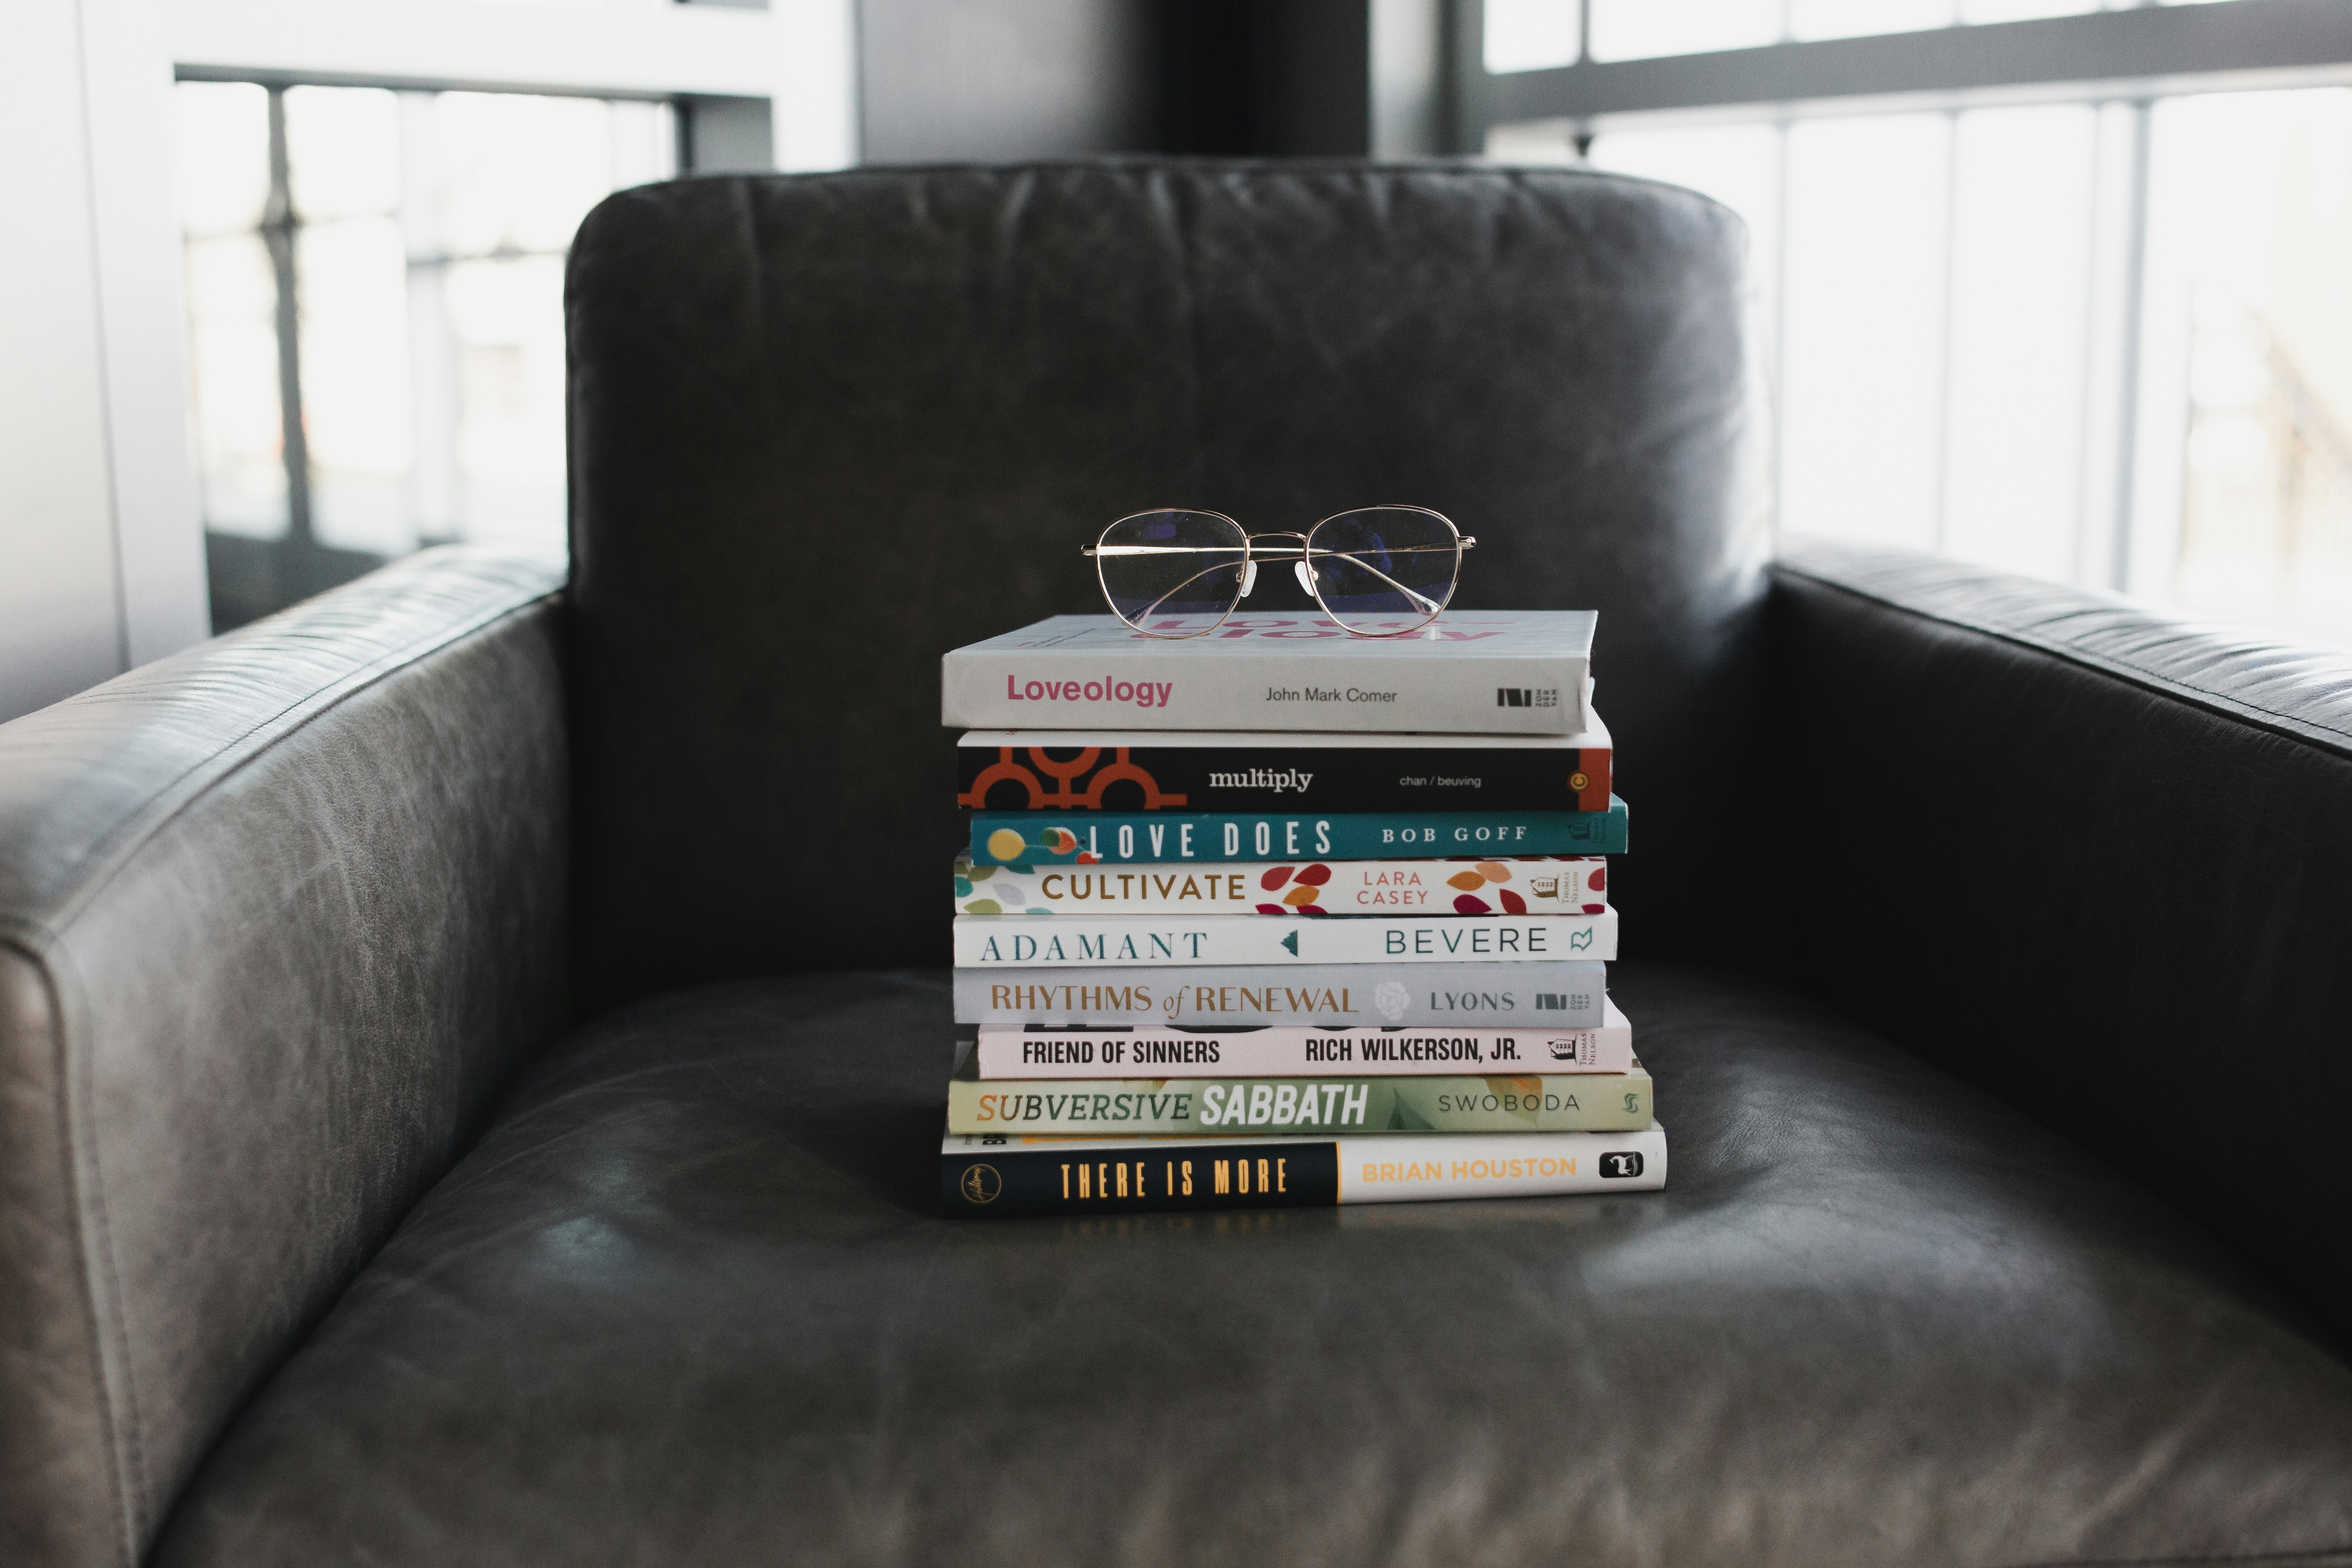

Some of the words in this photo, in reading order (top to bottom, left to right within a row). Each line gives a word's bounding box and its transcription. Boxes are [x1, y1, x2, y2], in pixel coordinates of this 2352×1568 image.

[1008, 675, 1173, 707] Loveology
[1266, 687, 1300, 701] John
[1305, 687, 1341, 701] Mark
[1346, 687, 1397, 702] Comer
[1210, 768, 1313, 793] multiply
[1399, 776, 1427, 786] chan
[1437, 776, 1482, 788] beuving
[1090, 824, 1194, 859] LOVE
[1224, 820, 1330, 856] DOES
[1383, 828, 1435, 843] BOB
[1454, 826, 1526, 841] GOFF
[1042, 874, 1245, 900] CULTIVATE
[1364, 871, 1421, 885] LARA
[1357, 890, 1428, 905] CASEY
[981, 933, 1207, 961] ADAMANT
[1386, 928, 1547, 954] BEVERE
[992, 985, 1152, 1011] RHYTHMS
[1163, 985, 1190, 1020] of
[1196, 987, 1357, 1013] RENEWAL
[1431, 992, 1515, 1011] LYONS
[1023, 1041, 1093, 1063] FRIEND
[1102, 1041, 1125, 1063] OF
[1133, 1041, 1220, 1063] SINNERS
[1306, 1038, 1352, 1061] RICH
[1361, 1038, 1483, 1063] WILKERSON,
[1491, 1038, 1521, 1060] JR.
[977, 1093, 1193, 1121] SUBVERSIVE
[1200, 1084, 1369, 1126] SABBATH
[1438, 1093, 1580, 1113] SWOBODA
[1061, 1162, 1145, 1199] THERE
[1167, 1161, 1192, 1195] IS
[1214, 1158, 1286, 1194] MORE
[1363, 1162, 1442, 1182] BRIAN
[1452, 1158, 1576, 1179] HOUSTON
